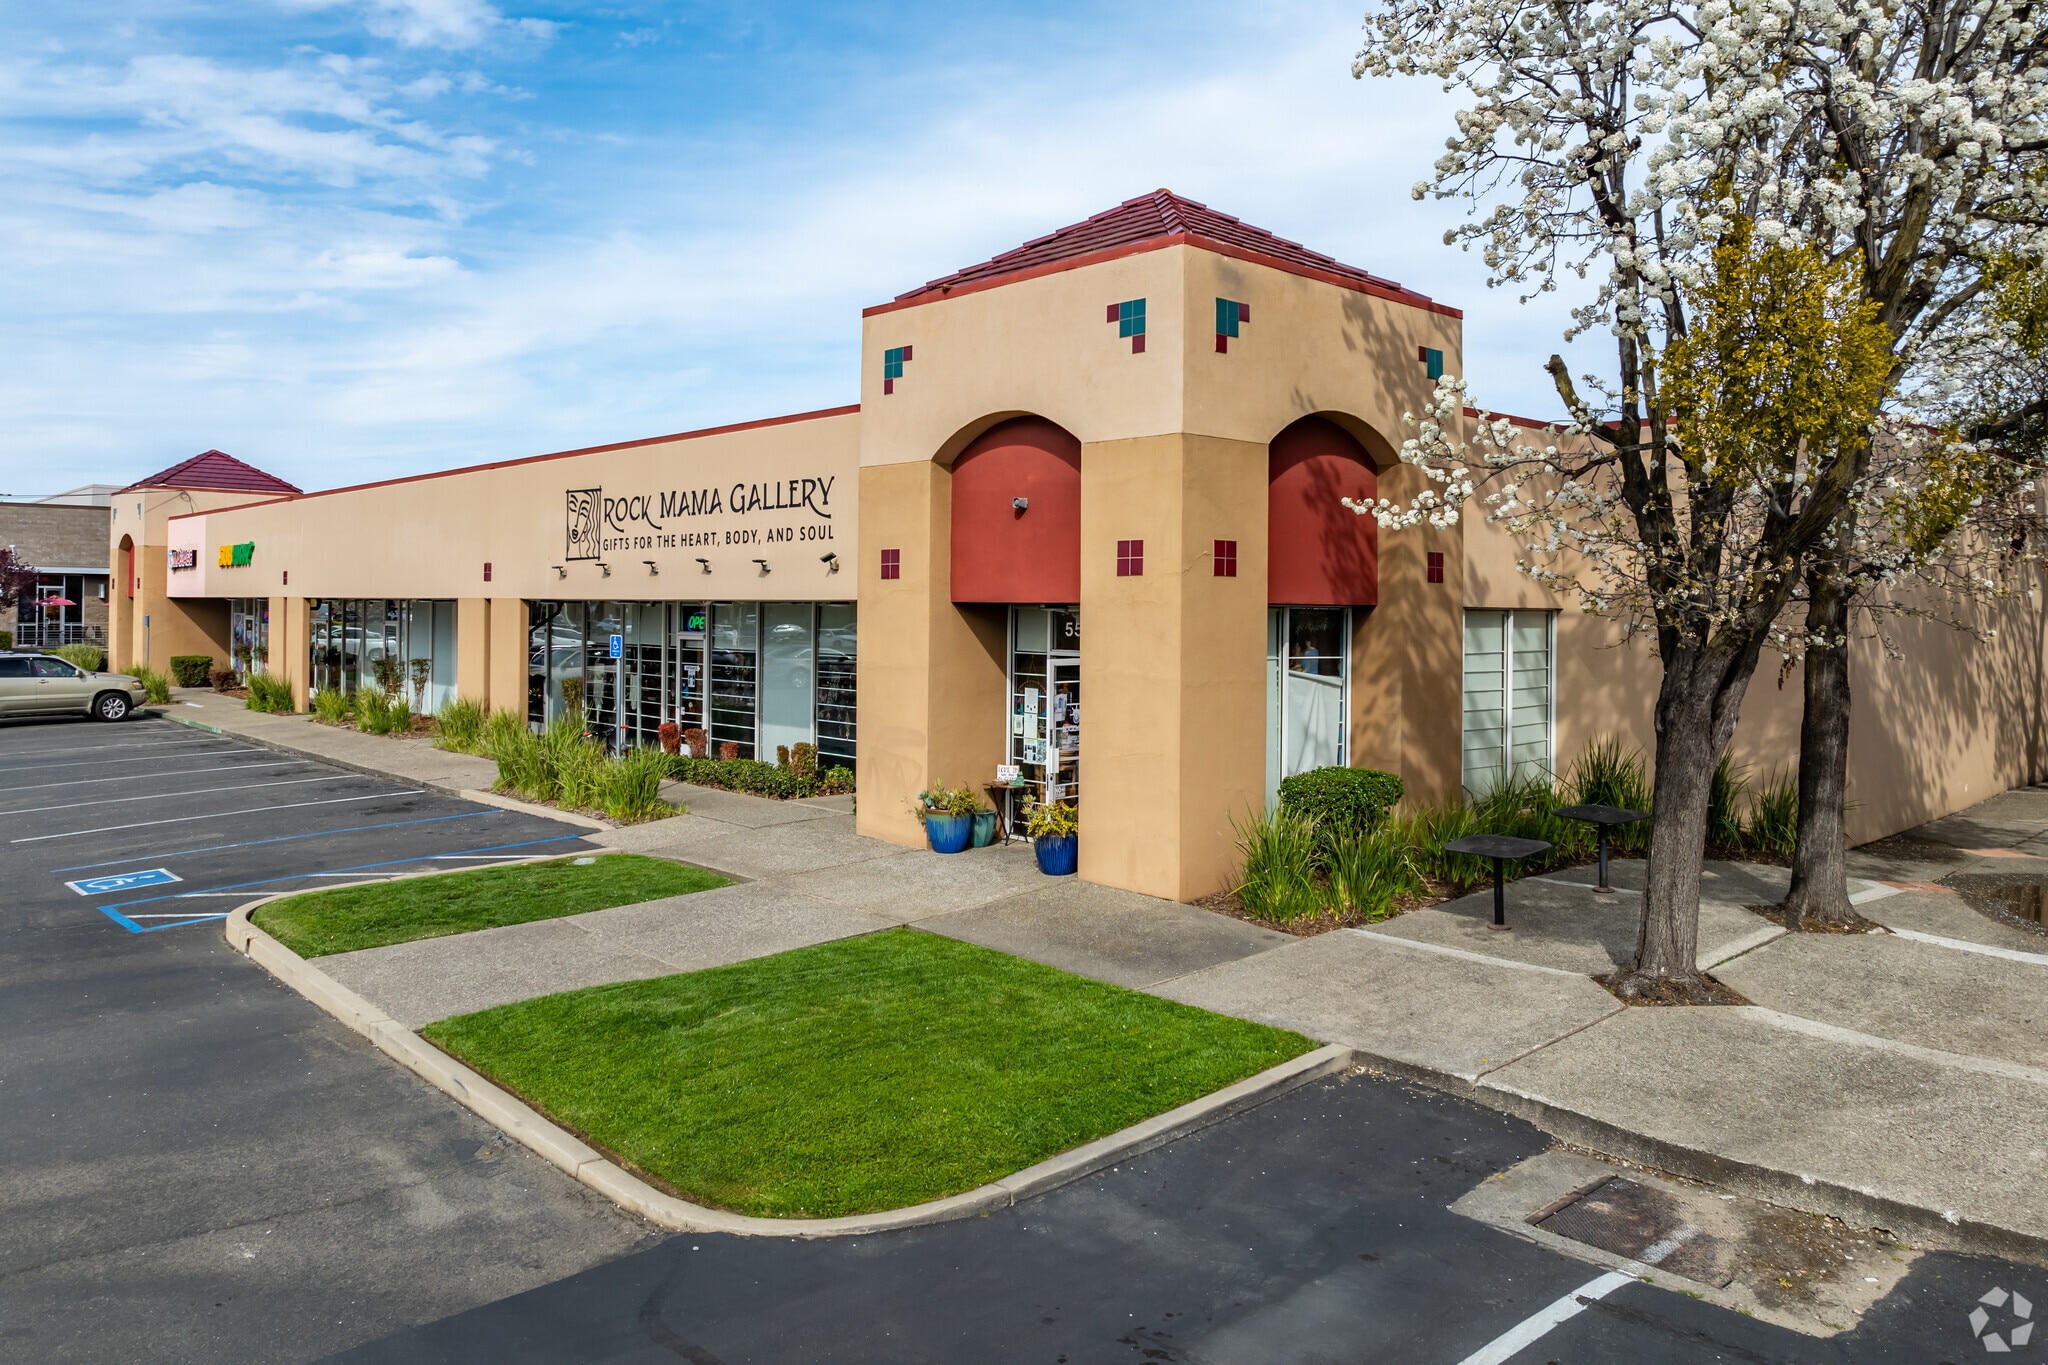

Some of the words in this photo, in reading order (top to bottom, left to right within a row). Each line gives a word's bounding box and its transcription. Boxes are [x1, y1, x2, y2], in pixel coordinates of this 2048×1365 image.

[603, 495, 662, 533] ROCK
[660, 488, 723, 519] MAMA
[729, 476, 835, 519] GALLERY
[603, 537, 630, 552] GIFTS
[633, 535, 653, 550] FOR
[656, 534, 676, 548] THE
[680, 531, 721, 547] HEART,
[725, 528, 761, 545] BODY,
[766, 526, 794, 543] AND
[799, 524, 835, 541] SOUL
[689, 615, 706, 630] OPE
